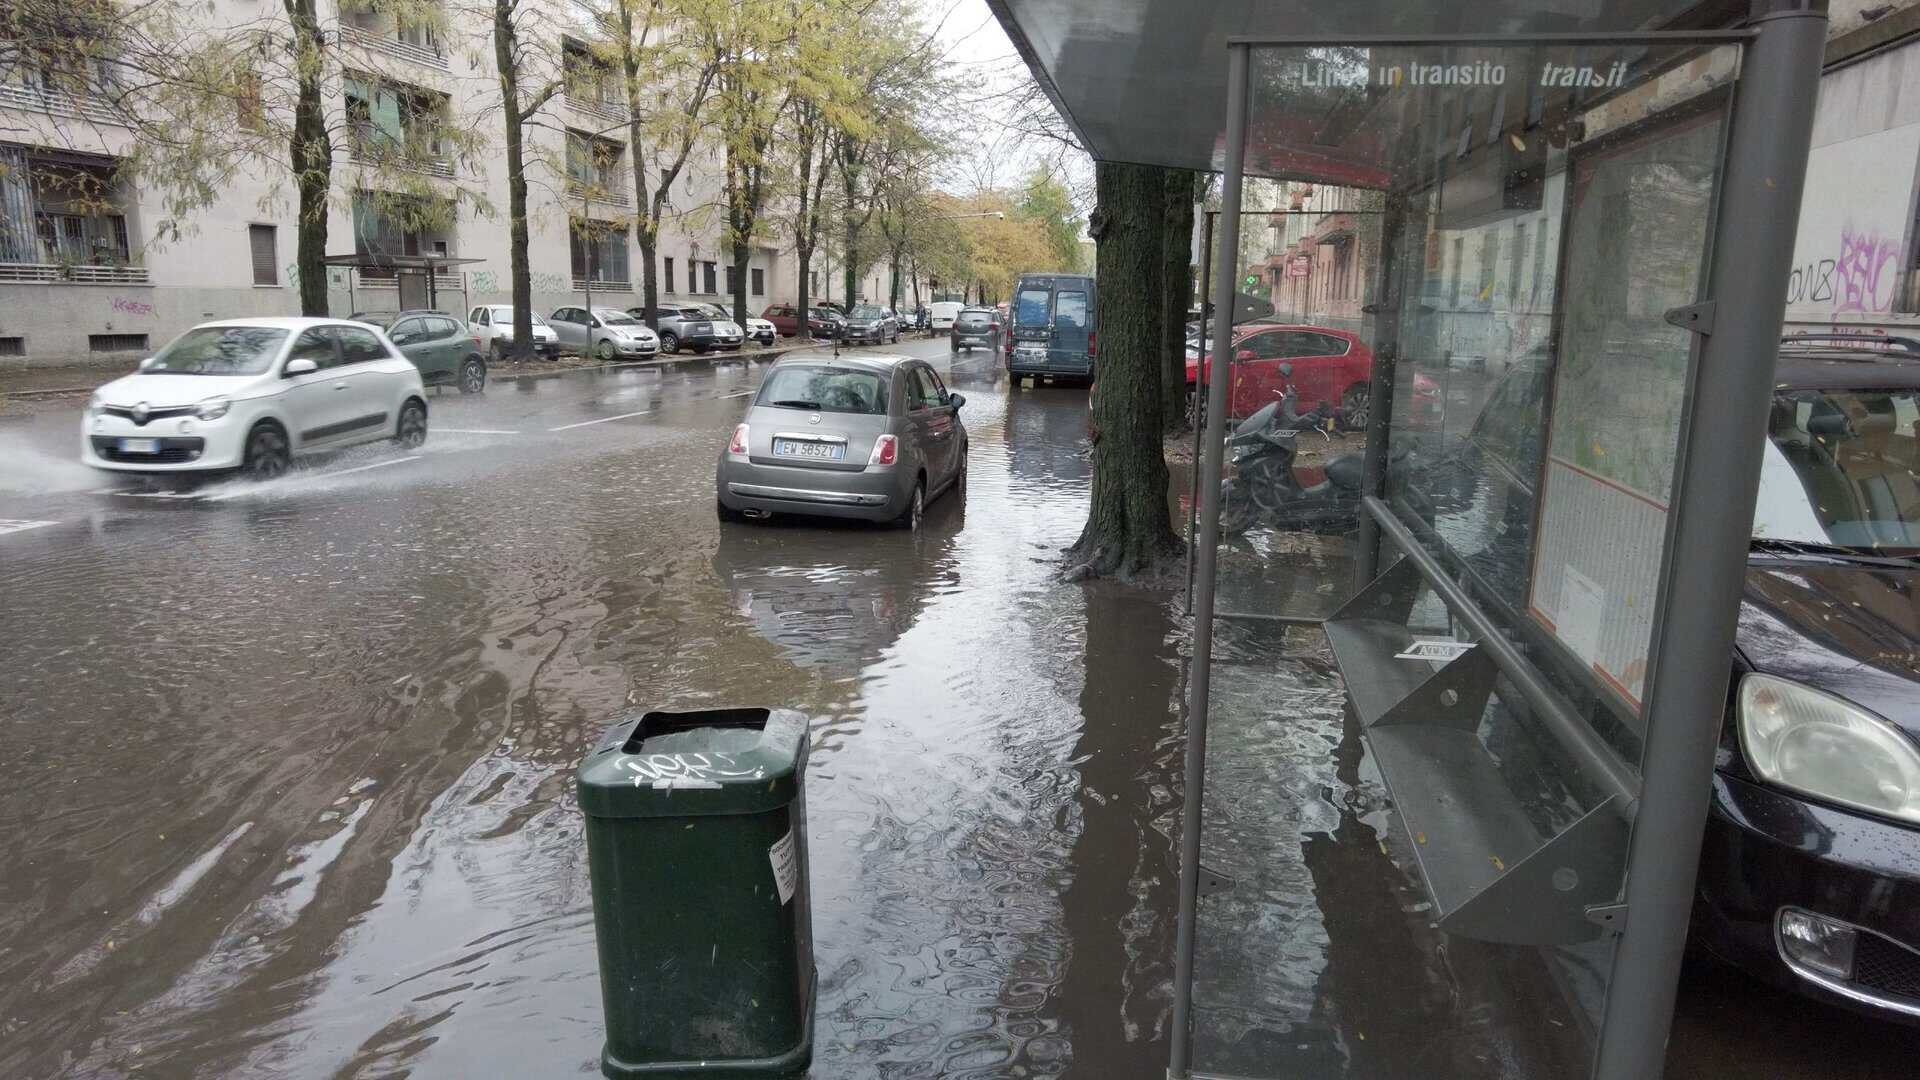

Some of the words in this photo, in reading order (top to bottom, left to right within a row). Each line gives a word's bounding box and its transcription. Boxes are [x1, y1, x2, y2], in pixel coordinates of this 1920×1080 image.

[1378, 63, 1403, 86] in
[1410, 61, 1505, 86] transito
[783, 441, 798, 455] EW
[1419, 645, 1450, 657] ATM
